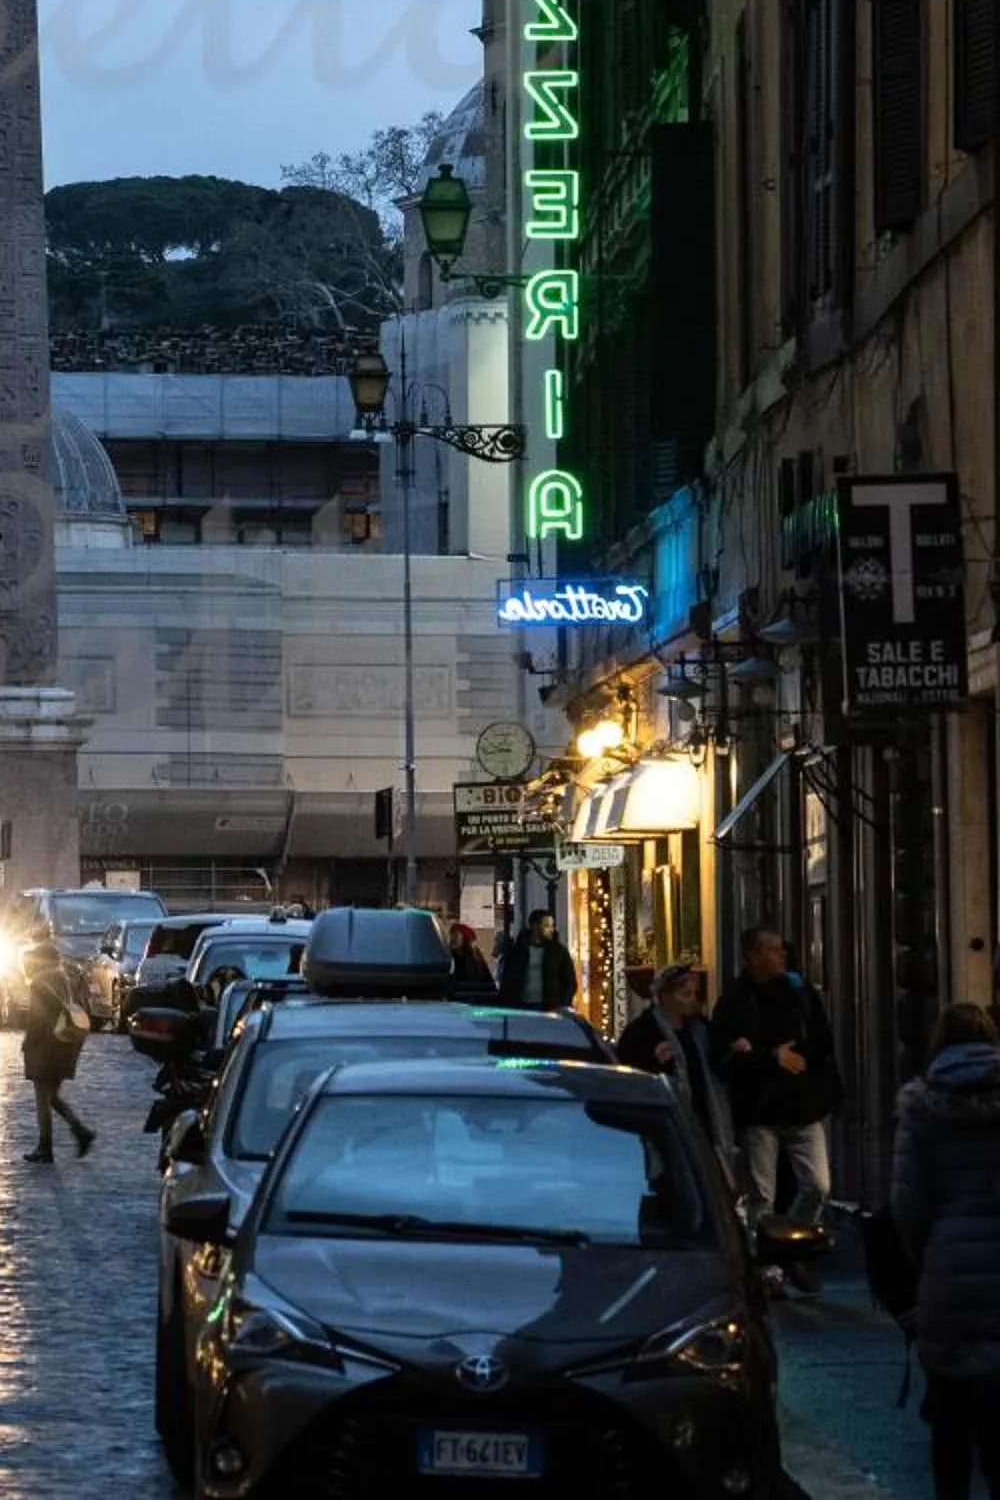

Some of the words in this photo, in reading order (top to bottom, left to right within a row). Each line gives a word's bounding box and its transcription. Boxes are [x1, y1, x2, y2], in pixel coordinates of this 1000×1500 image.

[852, 483, 947, 623] T
[867, 641, 923, 663] SALE
[931, 640, 944, 661] E
[856, 664, 959, 688] TABACCHI
